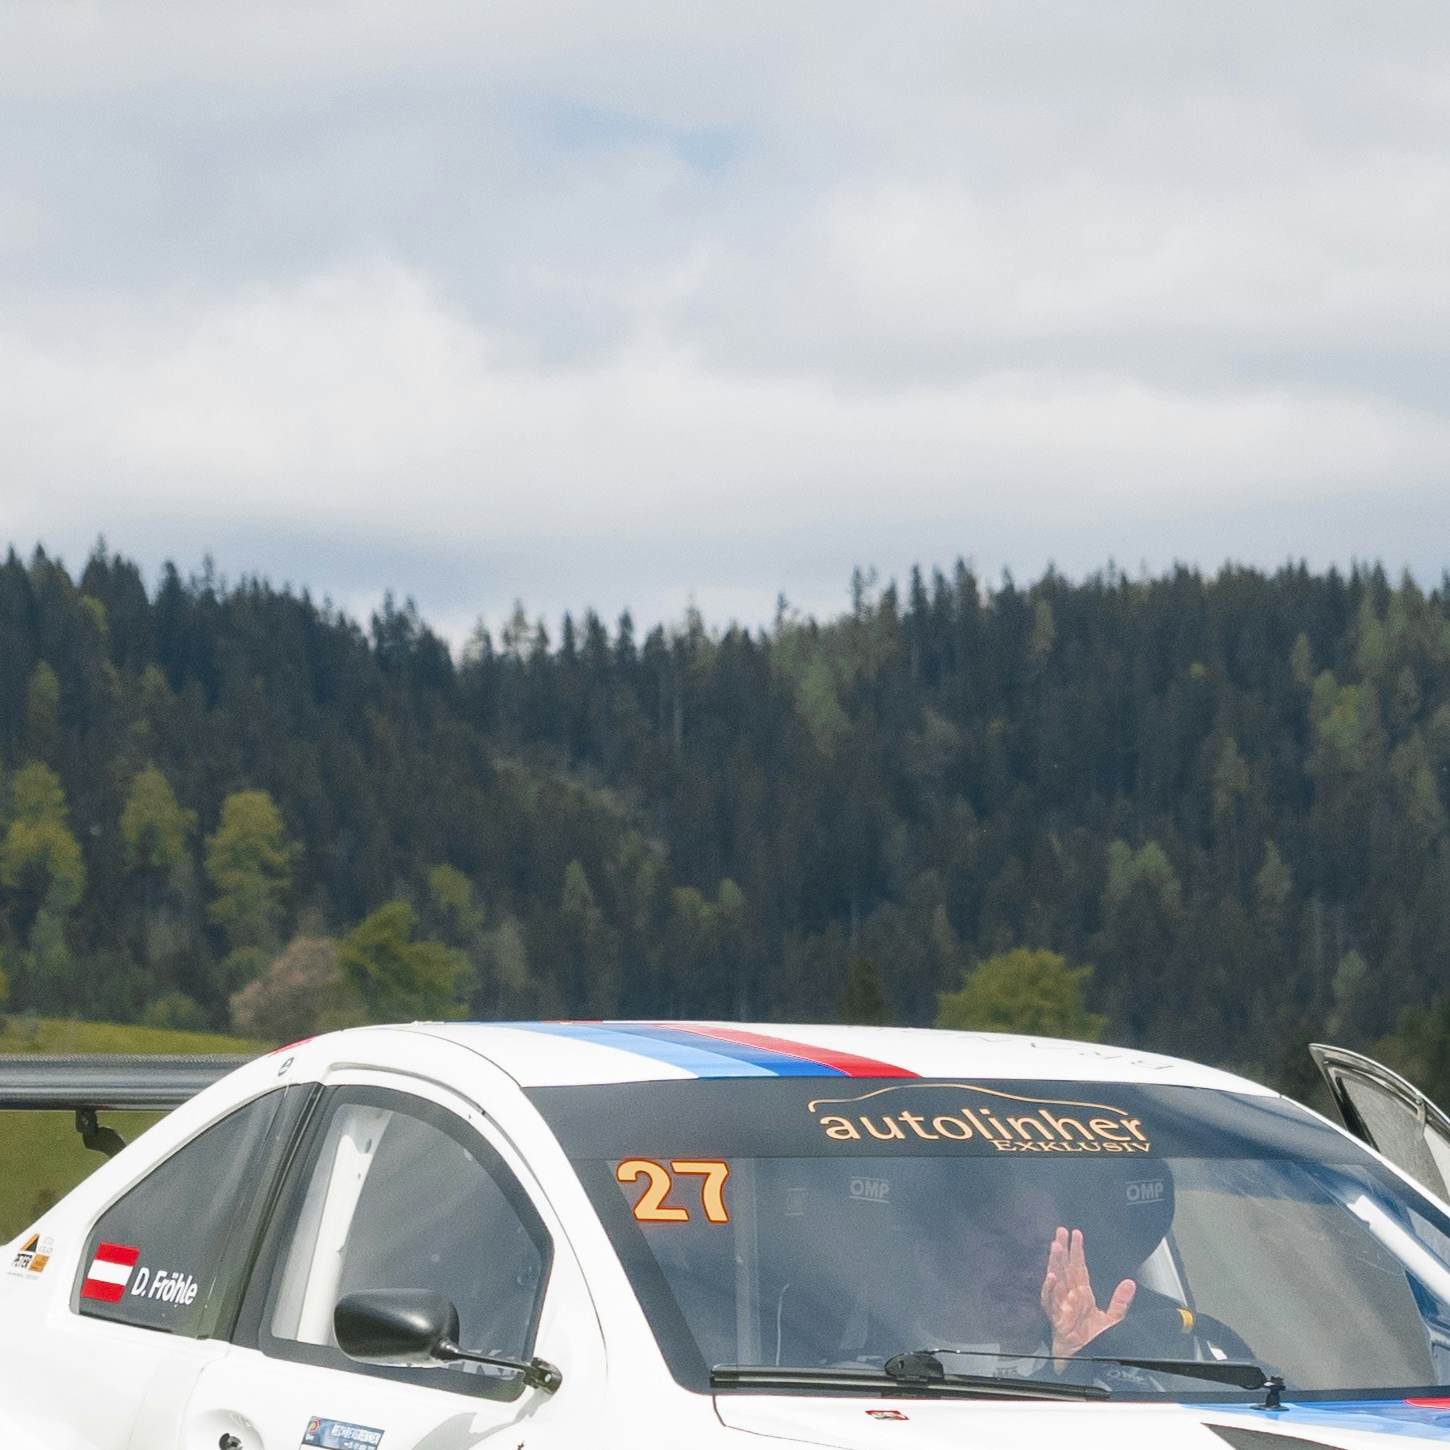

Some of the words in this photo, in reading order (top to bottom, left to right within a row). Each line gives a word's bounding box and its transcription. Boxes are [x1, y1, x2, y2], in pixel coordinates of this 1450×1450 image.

[818, 1107, 1147, 1142] autolinher
[616, 1157, 730, 1223] 27
[849, 1178, 890, 1200] OMP
[1125, 1181, 1165, 1201] OMP
[130, 1267, 148, 1297] D.
[148, 1269, 199, 1306] Fröhle
